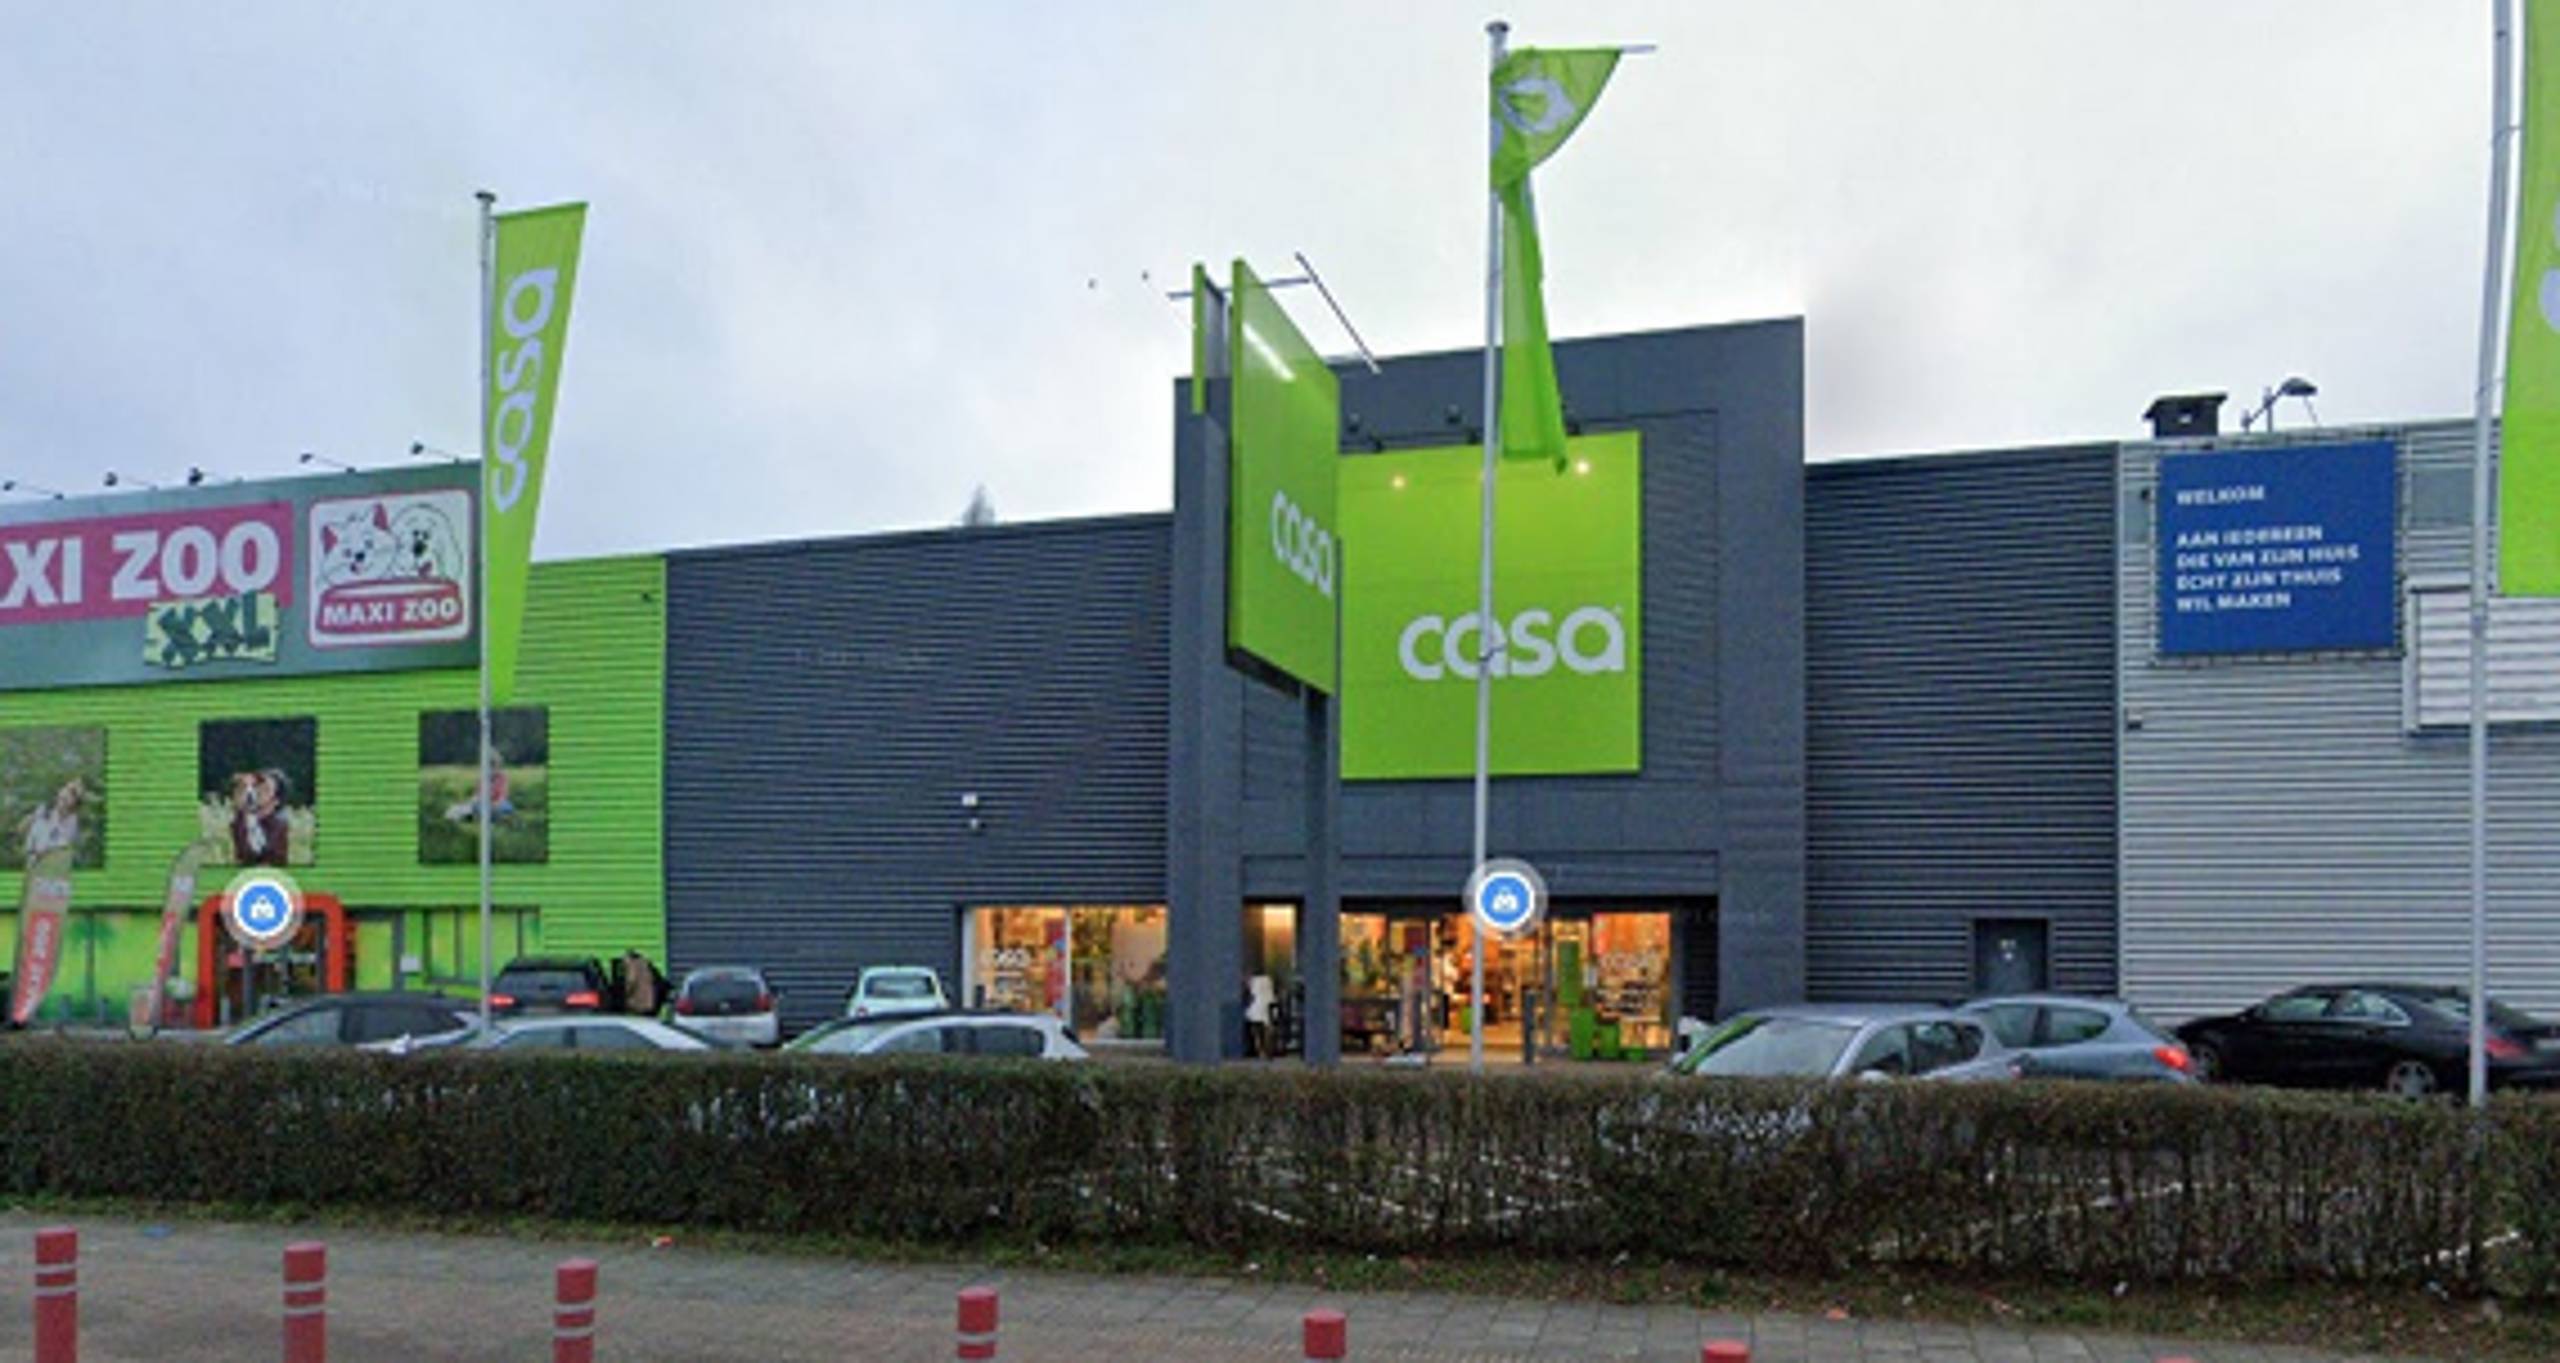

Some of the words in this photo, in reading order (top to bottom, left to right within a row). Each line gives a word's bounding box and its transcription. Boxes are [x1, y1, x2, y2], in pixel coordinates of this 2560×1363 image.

[493, 268, 559, 513] casa
[2176, 485, 2265, 505] WELKOM
[1271, 488, 1334, 598] casa
[2176, 530, 2219, 548] AAN
[2222, 525, 2323, 545] IEDEREEN
[0, 536, 83, 609] XI
[111, 520, 281, 600] ZOO
[2176, 551, 2209, 569] DIE
[2212, 550, 2255, 568] VAN
[2259, 548, 2304, 564] ZIJN
[2307, 543, 2360, 563] HUIS
[2230, 570, 2276, 588] ZIJN
[2280, 566, 2342, 585] THUIS
[322, 602, 394, 627] MAXI
[401, 596, 459, 623] ZOO
[2176, 596, 2213, 613] WIL
[2217, 592, 2292, 610] MAKEN
[156, 590, 270, 669] XXL
[1399, 605, 1625, 681] casa
